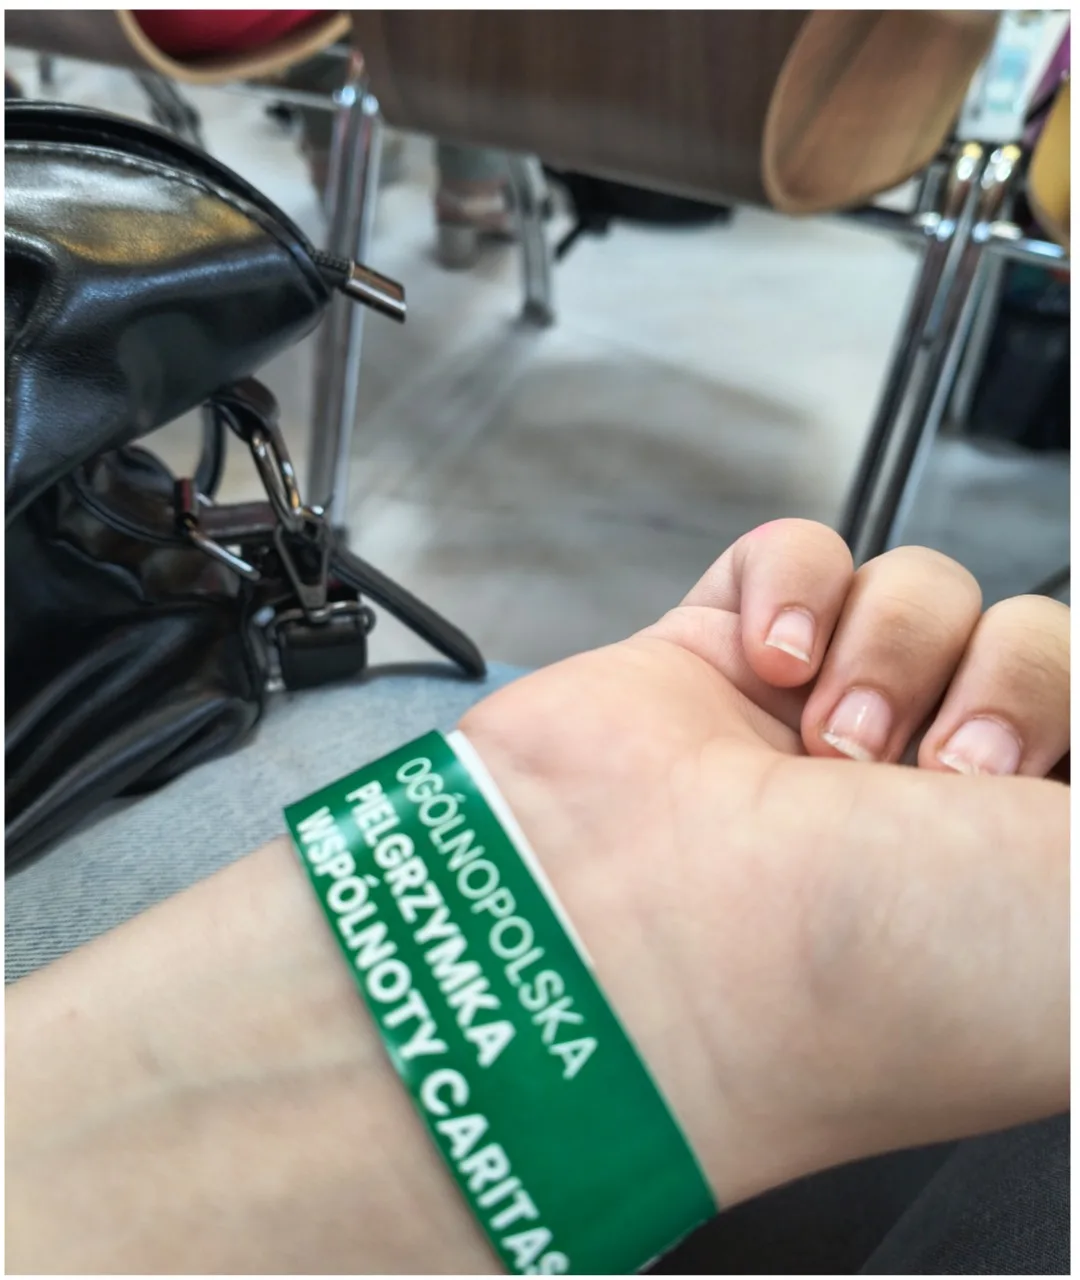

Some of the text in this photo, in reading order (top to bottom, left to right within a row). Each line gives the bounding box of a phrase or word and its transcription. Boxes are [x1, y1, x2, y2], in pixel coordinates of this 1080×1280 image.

[296, 806, 570, 1276] WSPÓLNOTY CARITAS
[346, 780, 517, 1068] PIELGRZYMKA
[396, 756, 598, 1079] OGÓLNOPOLSKA
